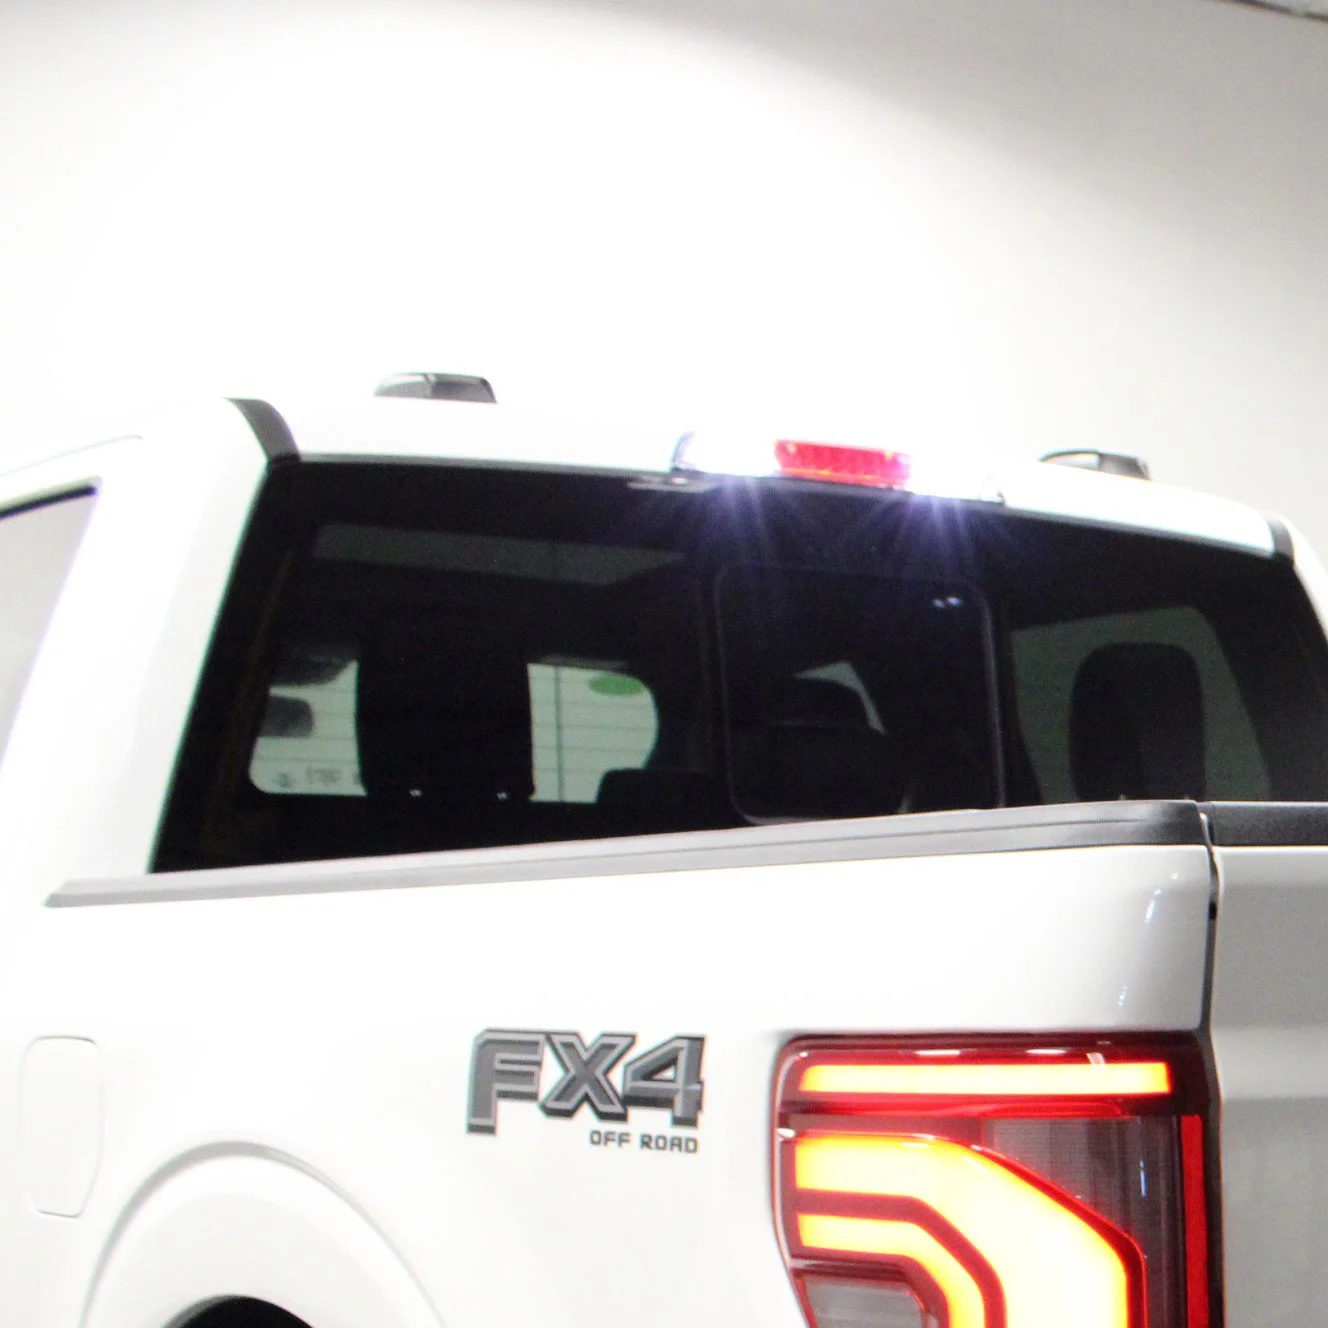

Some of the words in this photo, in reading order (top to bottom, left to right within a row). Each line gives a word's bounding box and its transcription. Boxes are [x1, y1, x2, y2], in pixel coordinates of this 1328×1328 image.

[466, 1027, 706, 1135] FX4
[589, 1129, 631, 1148] OFF
[639, 1133, 699, 1154] ROAD
